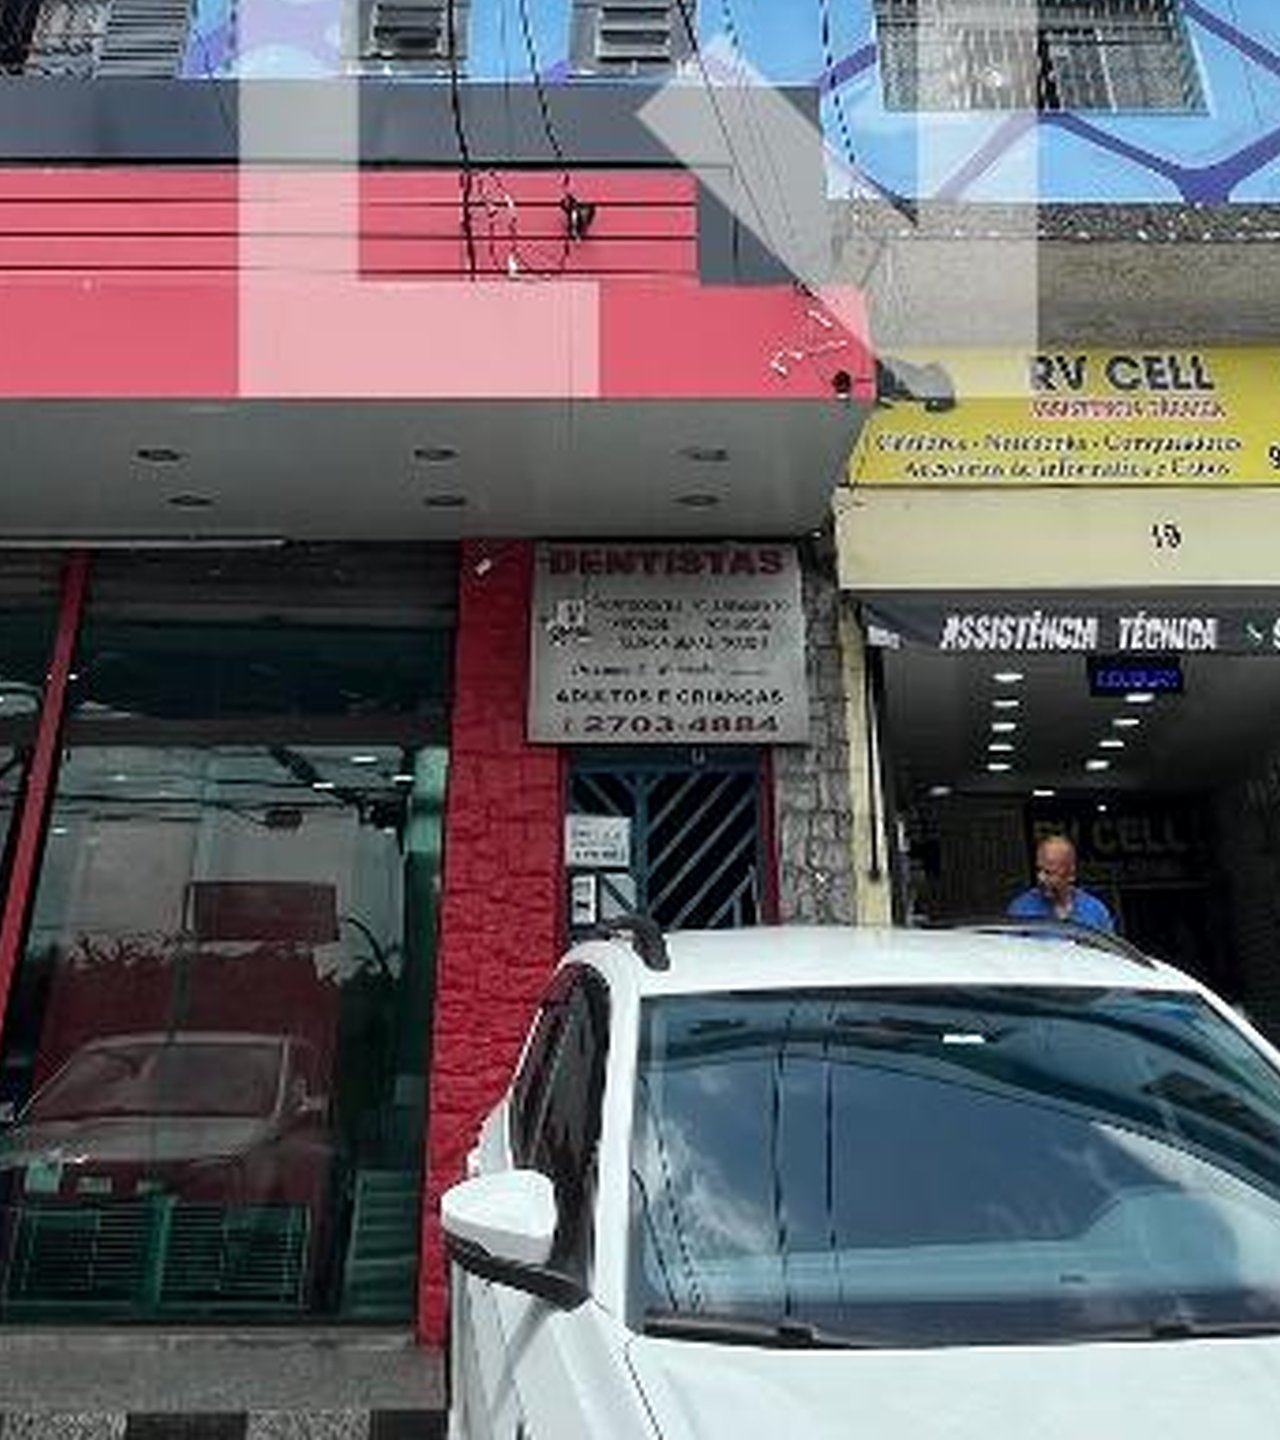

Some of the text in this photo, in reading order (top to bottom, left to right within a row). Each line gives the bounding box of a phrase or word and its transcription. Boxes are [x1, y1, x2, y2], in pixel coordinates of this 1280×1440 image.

[1030, 353, 1215, 391] RV CELL
[549, 547, 785, 575] DENTISTAS
[938, 610, 1099, 651] ASSISTÊNCIA
[1118, 610, 1218, 651] TÉCNICA
[555, 689, 785, 709] ADULTOS E CRIANÇAS
[584, 714, 780, 734] 2703-4884
